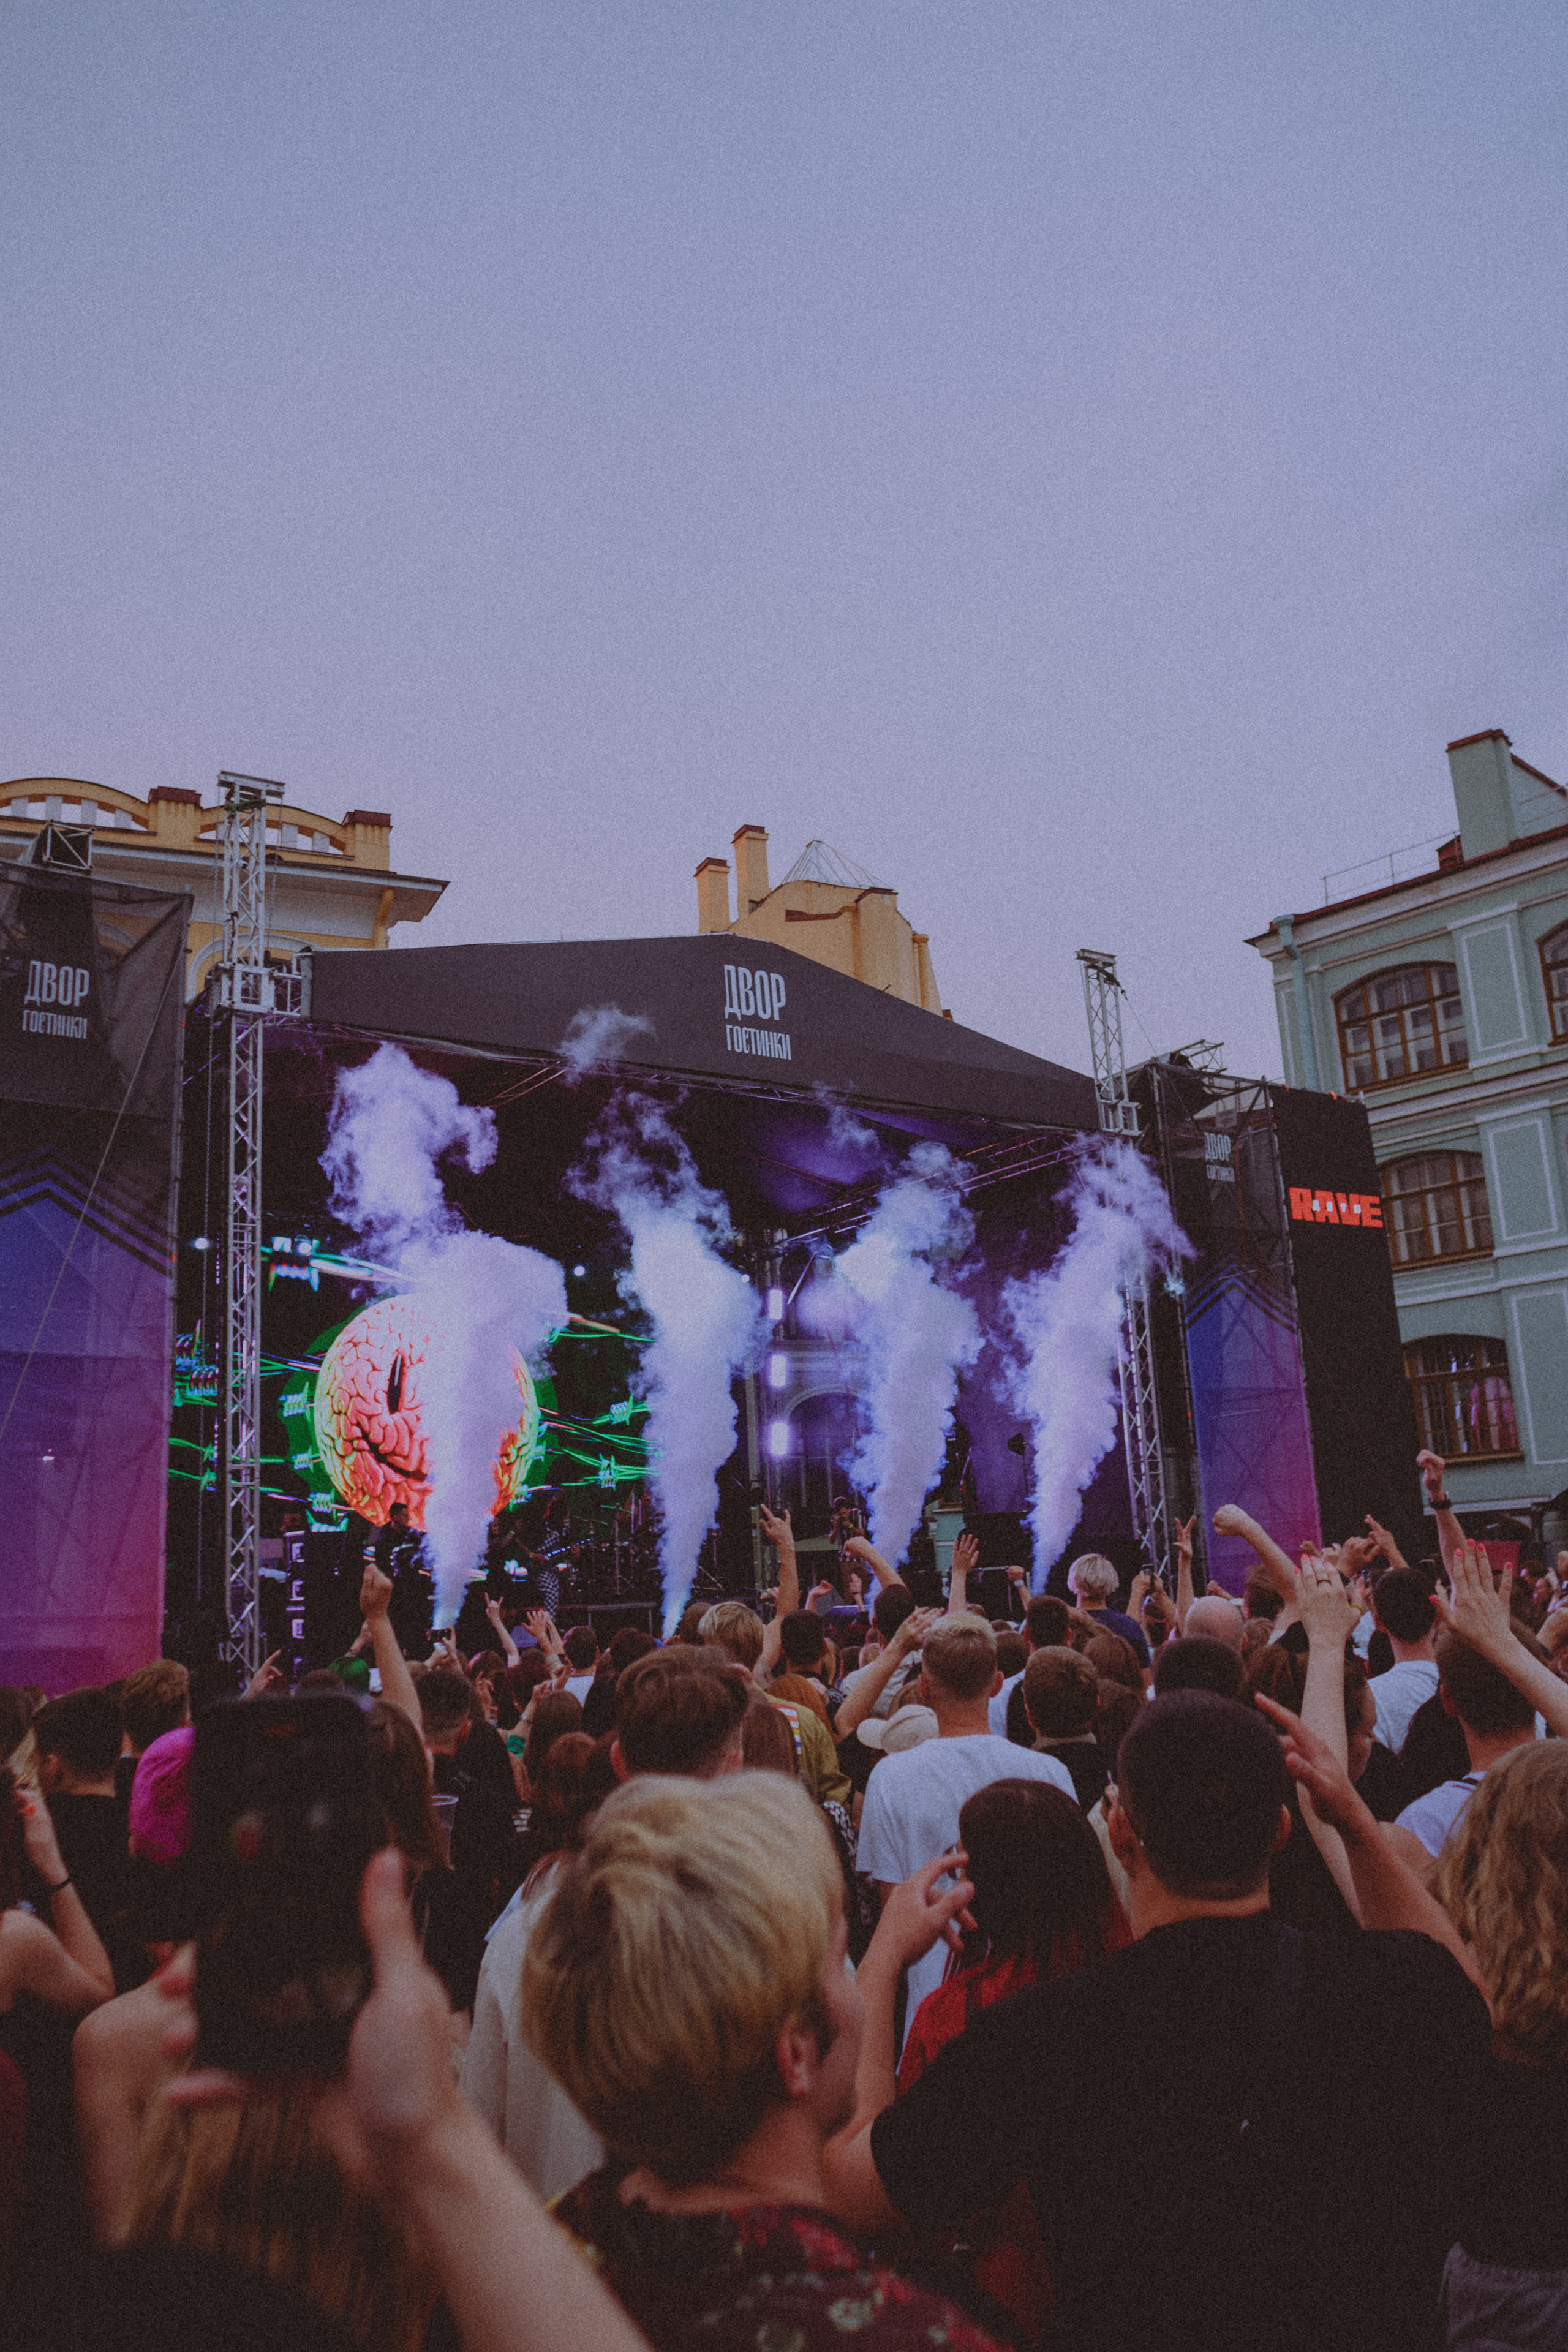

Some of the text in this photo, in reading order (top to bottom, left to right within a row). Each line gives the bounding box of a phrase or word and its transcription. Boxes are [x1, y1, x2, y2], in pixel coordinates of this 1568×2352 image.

[24, 960, 90, 1007] ДВОР
[724, 964, 786, 1021] ДВОР
[23, 1009, 88, 1039] ГОСТИНКИ
[726, 1024, 792, 1060] ГОСТИНКИ
[1289, 1187, 1384, 1228] RAVE
